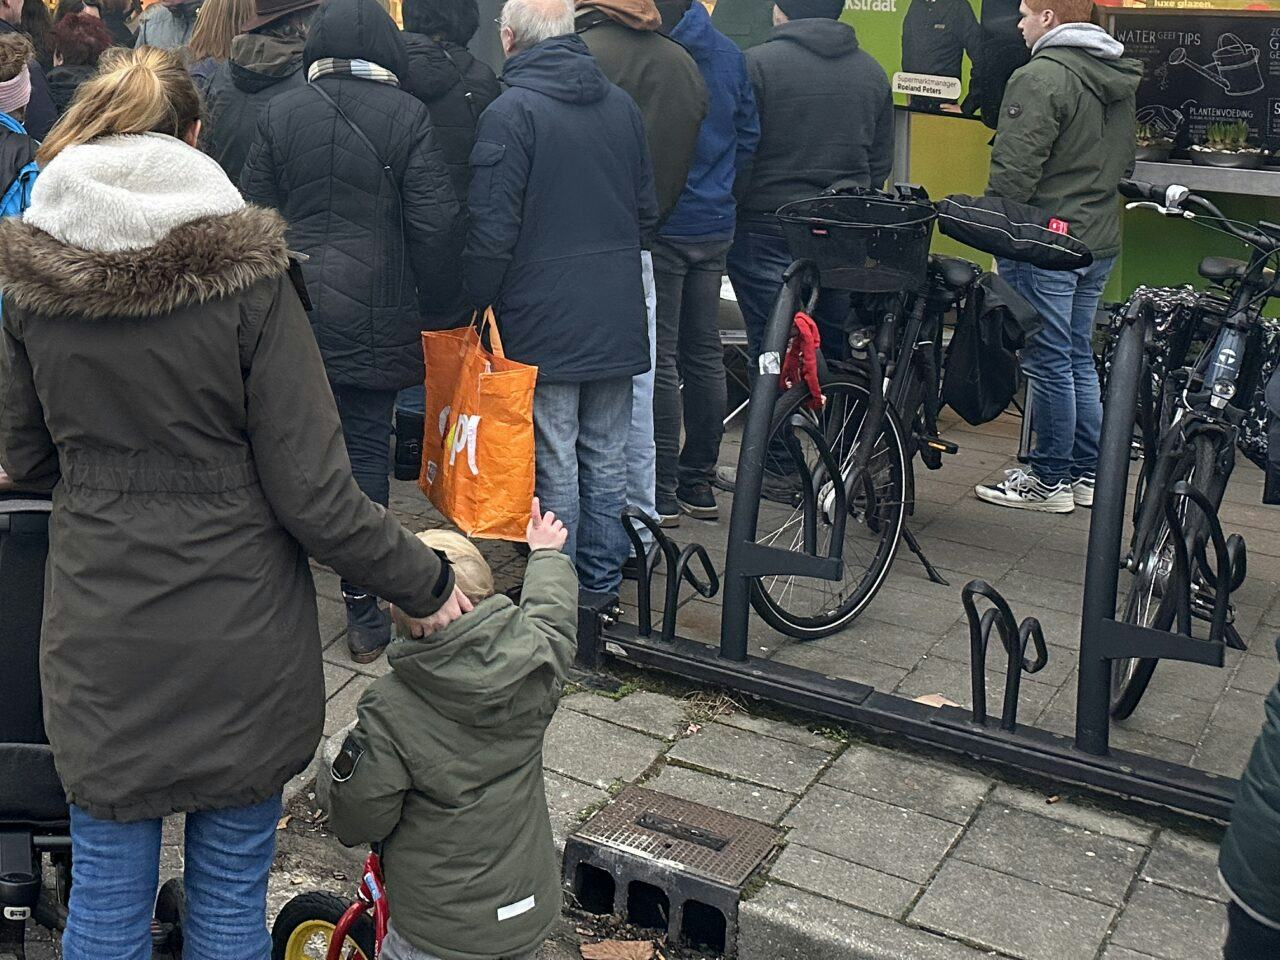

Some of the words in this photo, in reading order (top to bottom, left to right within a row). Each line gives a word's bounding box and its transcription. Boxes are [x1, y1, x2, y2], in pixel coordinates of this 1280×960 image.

[1154, 0, 1175, 7] luxe
[1116, 30, 1156, 44] WATER
[1178, 32, 1201, 45] TIPS
[897, 84, 921, 93] Roeland
[922, 86, 942, 95] Peters
[1189, 106, 1254, 119] PLANTENVOEDING
